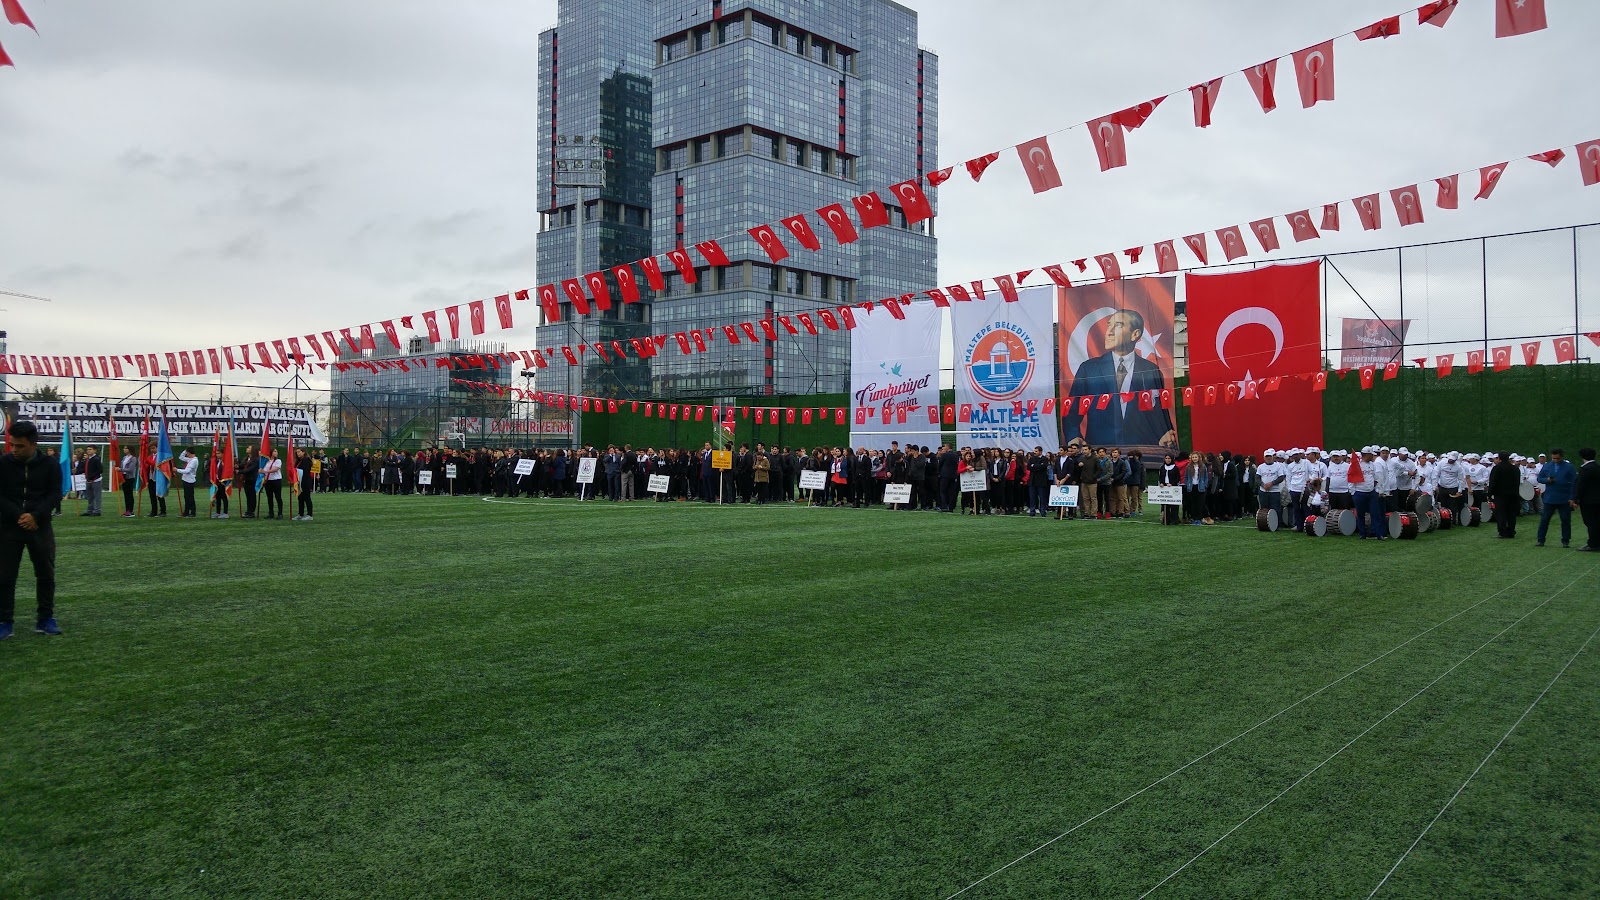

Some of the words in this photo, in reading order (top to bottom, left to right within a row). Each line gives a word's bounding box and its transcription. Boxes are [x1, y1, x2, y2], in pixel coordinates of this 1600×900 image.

[965, 324, 992, 362] MALTEPE
[995, 321, 1036, 357] BELEDİYESİ
[855, 373, 931, 408] Cumhuriyet
[18, 402, 73, 417] IŞIKLI
[76, 403, 162, 417] RAFLARDA
[166, 405, 249, 419] KUPALARIN
[970, 407, 1039, 424] MALTEPE
[82, 420, 139, 434] SOKAINDA
[189, 421, 260, 434] TARAFTALARIN
[970, 424, 1042, 439] BELEDİYESİ
